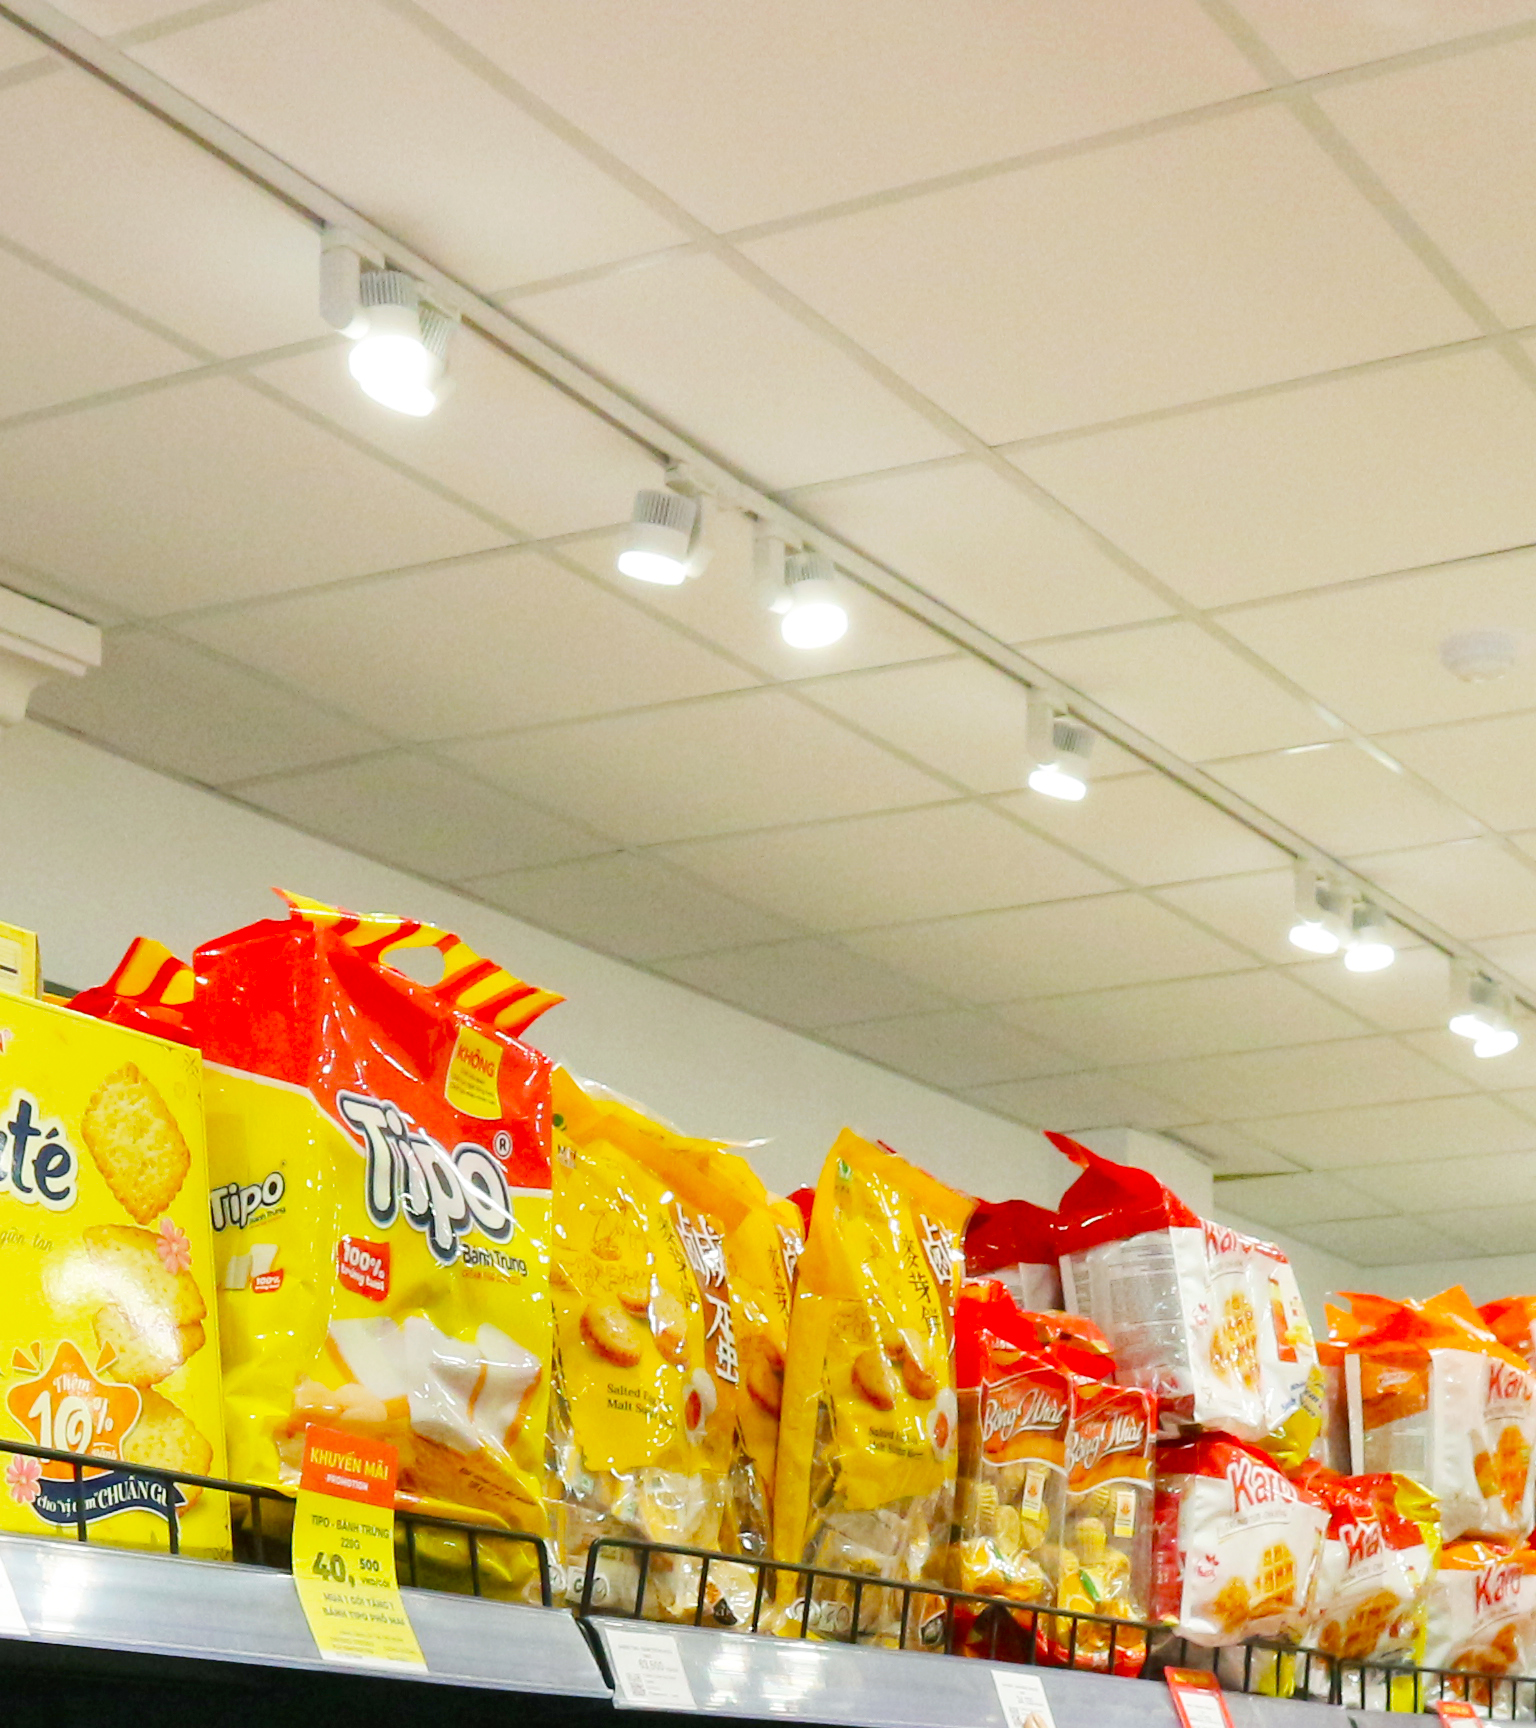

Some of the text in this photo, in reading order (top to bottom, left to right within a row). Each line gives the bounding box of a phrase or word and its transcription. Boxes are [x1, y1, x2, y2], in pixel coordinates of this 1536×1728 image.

[339, 1088, 515, 1265] Tipo
[209, 1171, 285, 1232] Tipo
[342, 1241, 385, 1279] 100%
[359, 1558, 380, 1572] 500
